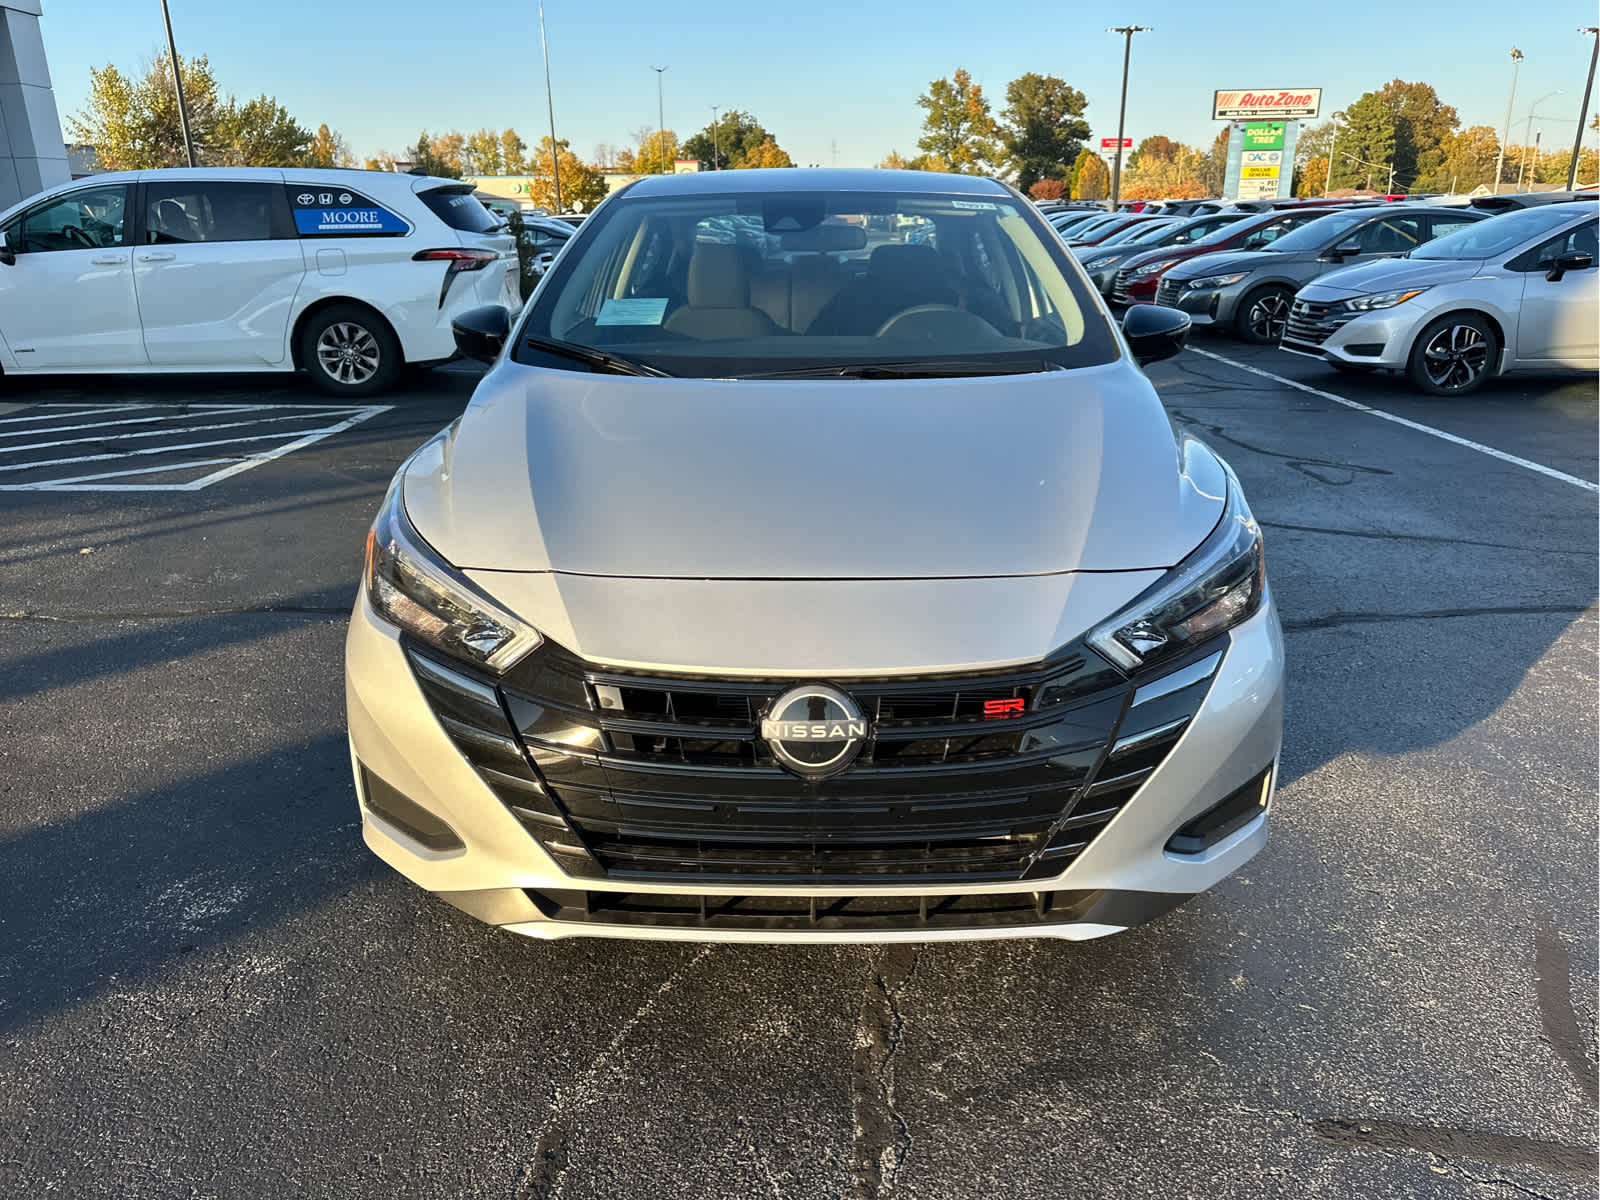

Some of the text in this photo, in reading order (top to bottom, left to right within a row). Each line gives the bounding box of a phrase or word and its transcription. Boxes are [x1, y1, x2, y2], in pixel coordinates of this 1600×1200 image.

[1239, 92, 1312, 106] AutoZone
[1246, 127, 1282, 136] DOLLAR
[1252, 136, 1276, 144] TREE
[322, 211, 378, 223] MOORE
[984, 698, 1024, 714] SR
[764, 721, 865, 738] NISSAN
